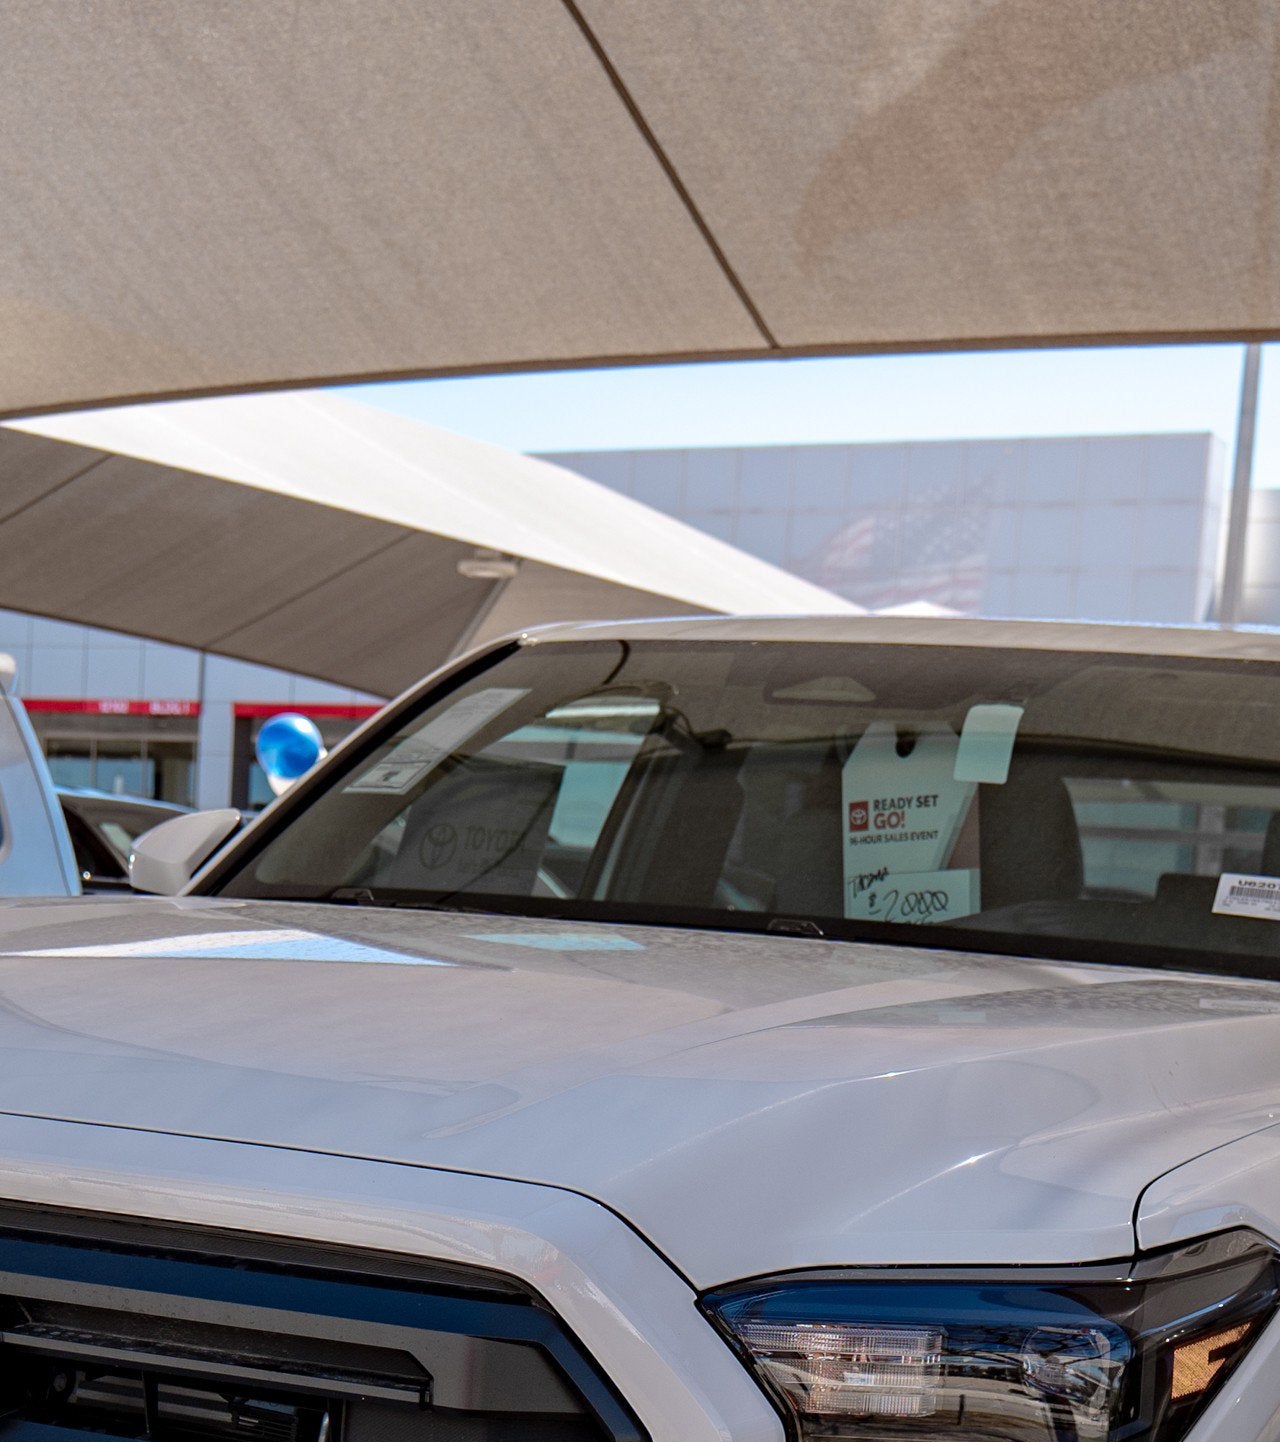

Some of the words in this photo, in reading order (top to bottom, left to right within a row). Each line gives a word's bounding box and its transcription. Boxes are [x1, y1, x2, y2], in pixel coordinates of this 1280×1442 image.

[873, 797, 912, 810] READY
[915, 794, 939, 808] SET
[874, 810, 906, 829] GO!
[884, 832, 909, 843] SALES
[910, 830, 939, 841] EVENT
